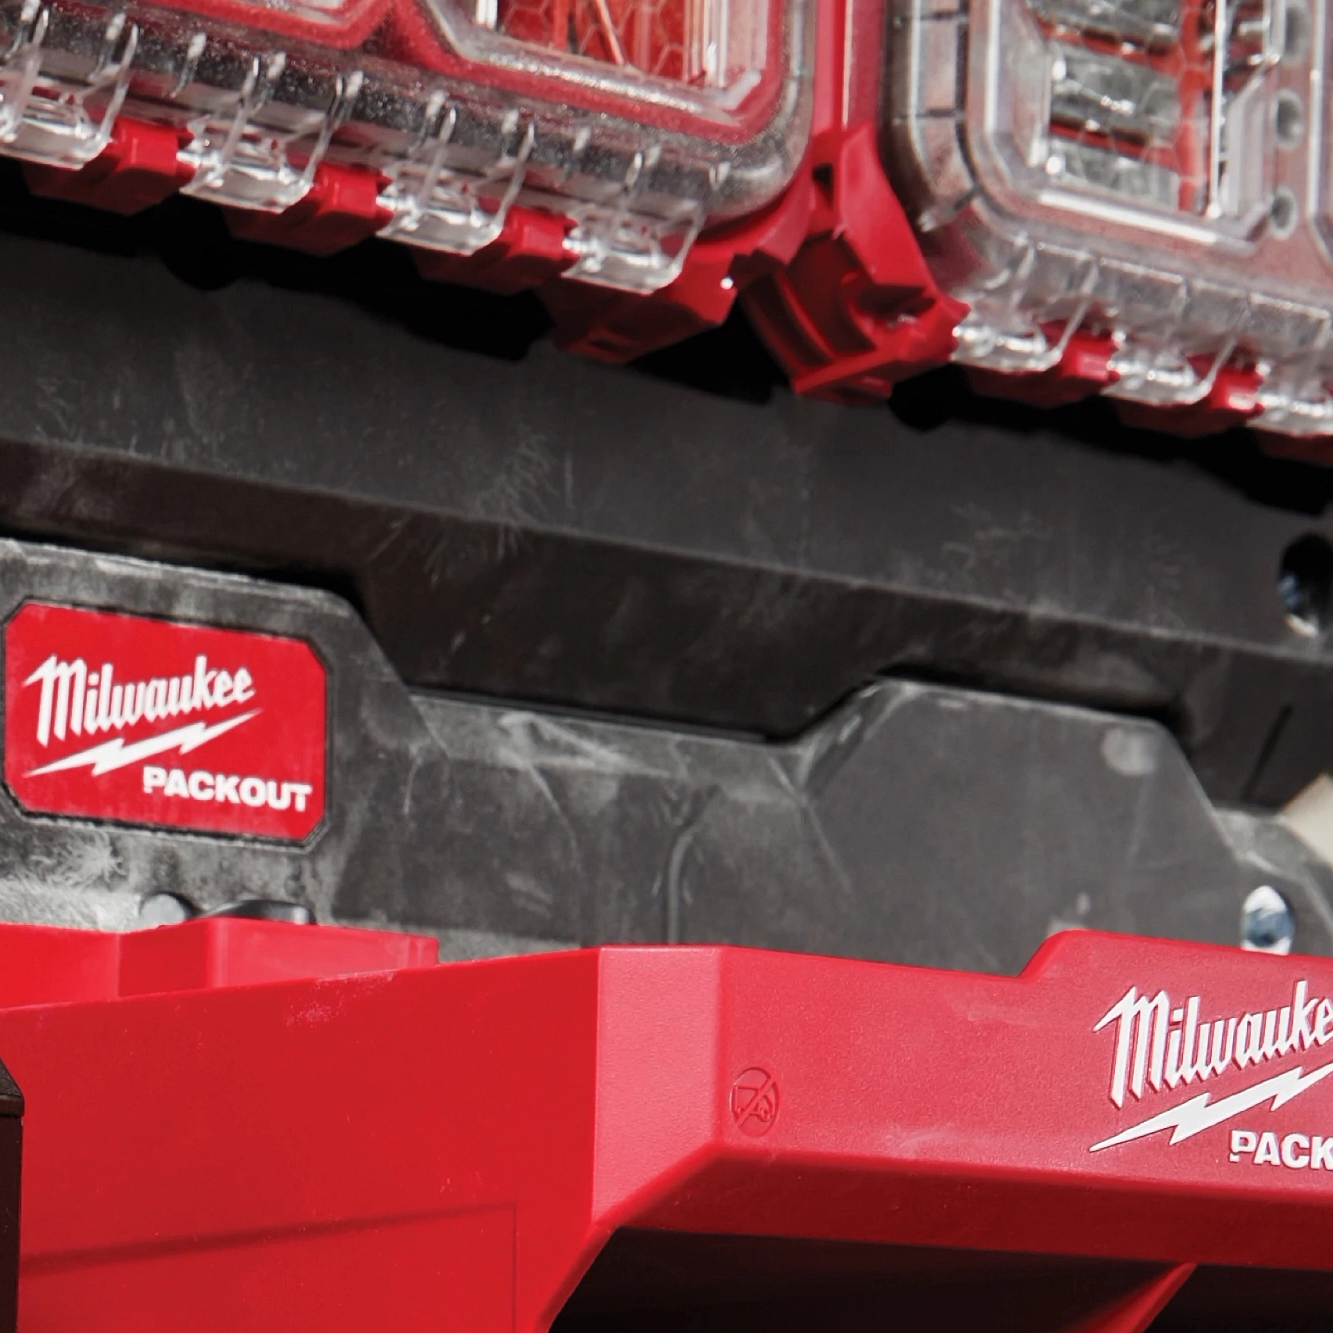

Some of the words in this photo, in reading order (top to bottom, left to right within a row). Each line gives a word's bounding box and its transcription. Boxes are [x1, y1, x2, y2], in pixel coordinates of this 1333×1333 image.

[21, 653, 256, 747] Milwaukee
[143, 765, 312, 812] PACKOUT
[1093, 979, 1333, 1108] Milwauke
[1230, 1129, 1333, 1170] PACK
